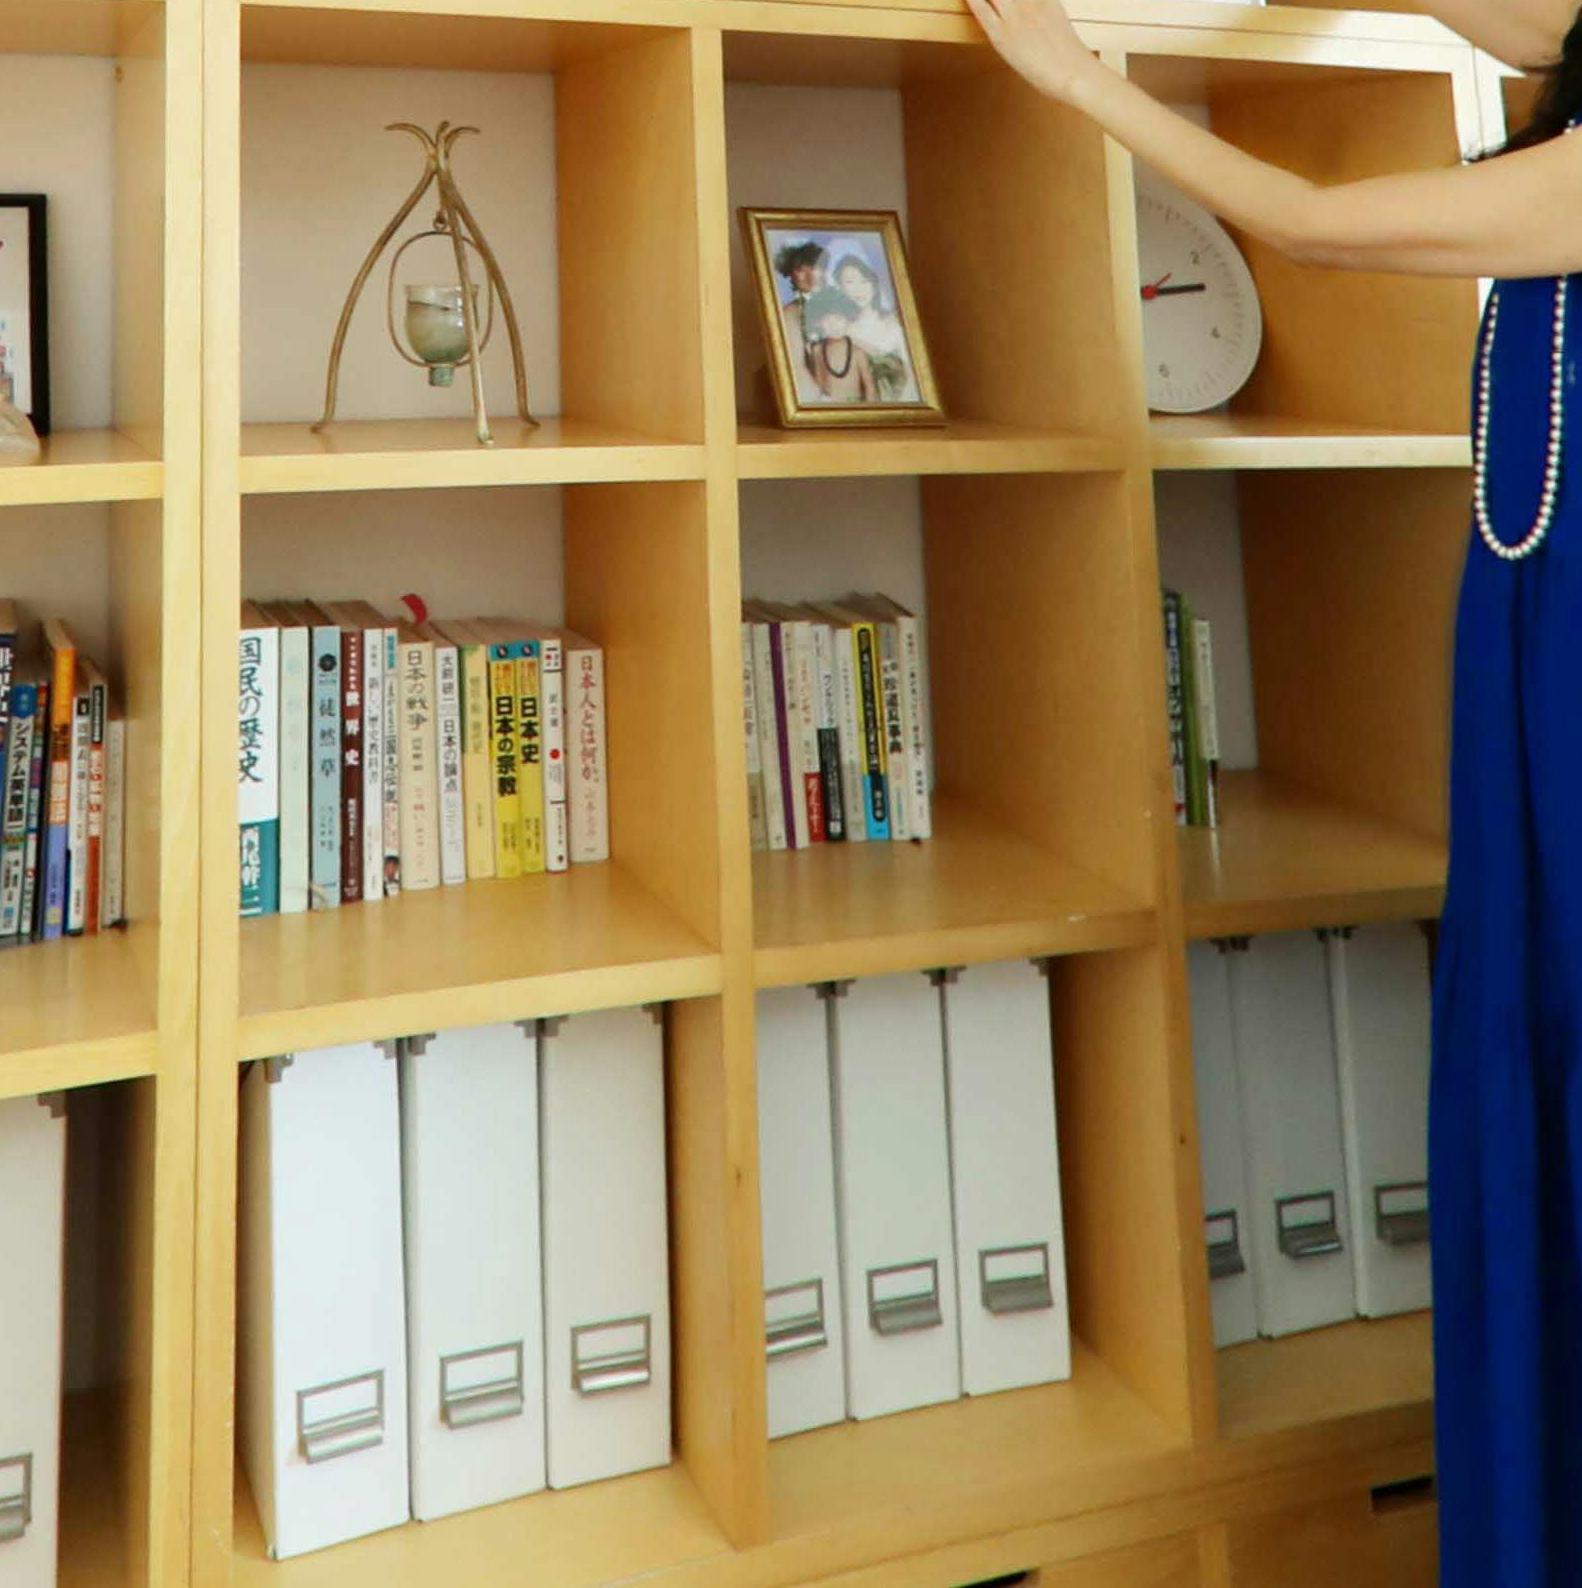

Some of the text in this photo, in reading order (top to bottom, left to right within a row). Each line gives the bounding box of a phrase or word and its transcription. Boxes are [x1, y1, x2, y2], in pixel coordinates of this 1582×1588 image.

[1190, 249, 1201, 266] 2
[239, 636, 263, 783] 国民の歴史
[405, 650, 428, 732] 日本の戦争
[520, 696, 540, 765] 日本史
[495, 695, 517, 798] 日本の宗教
